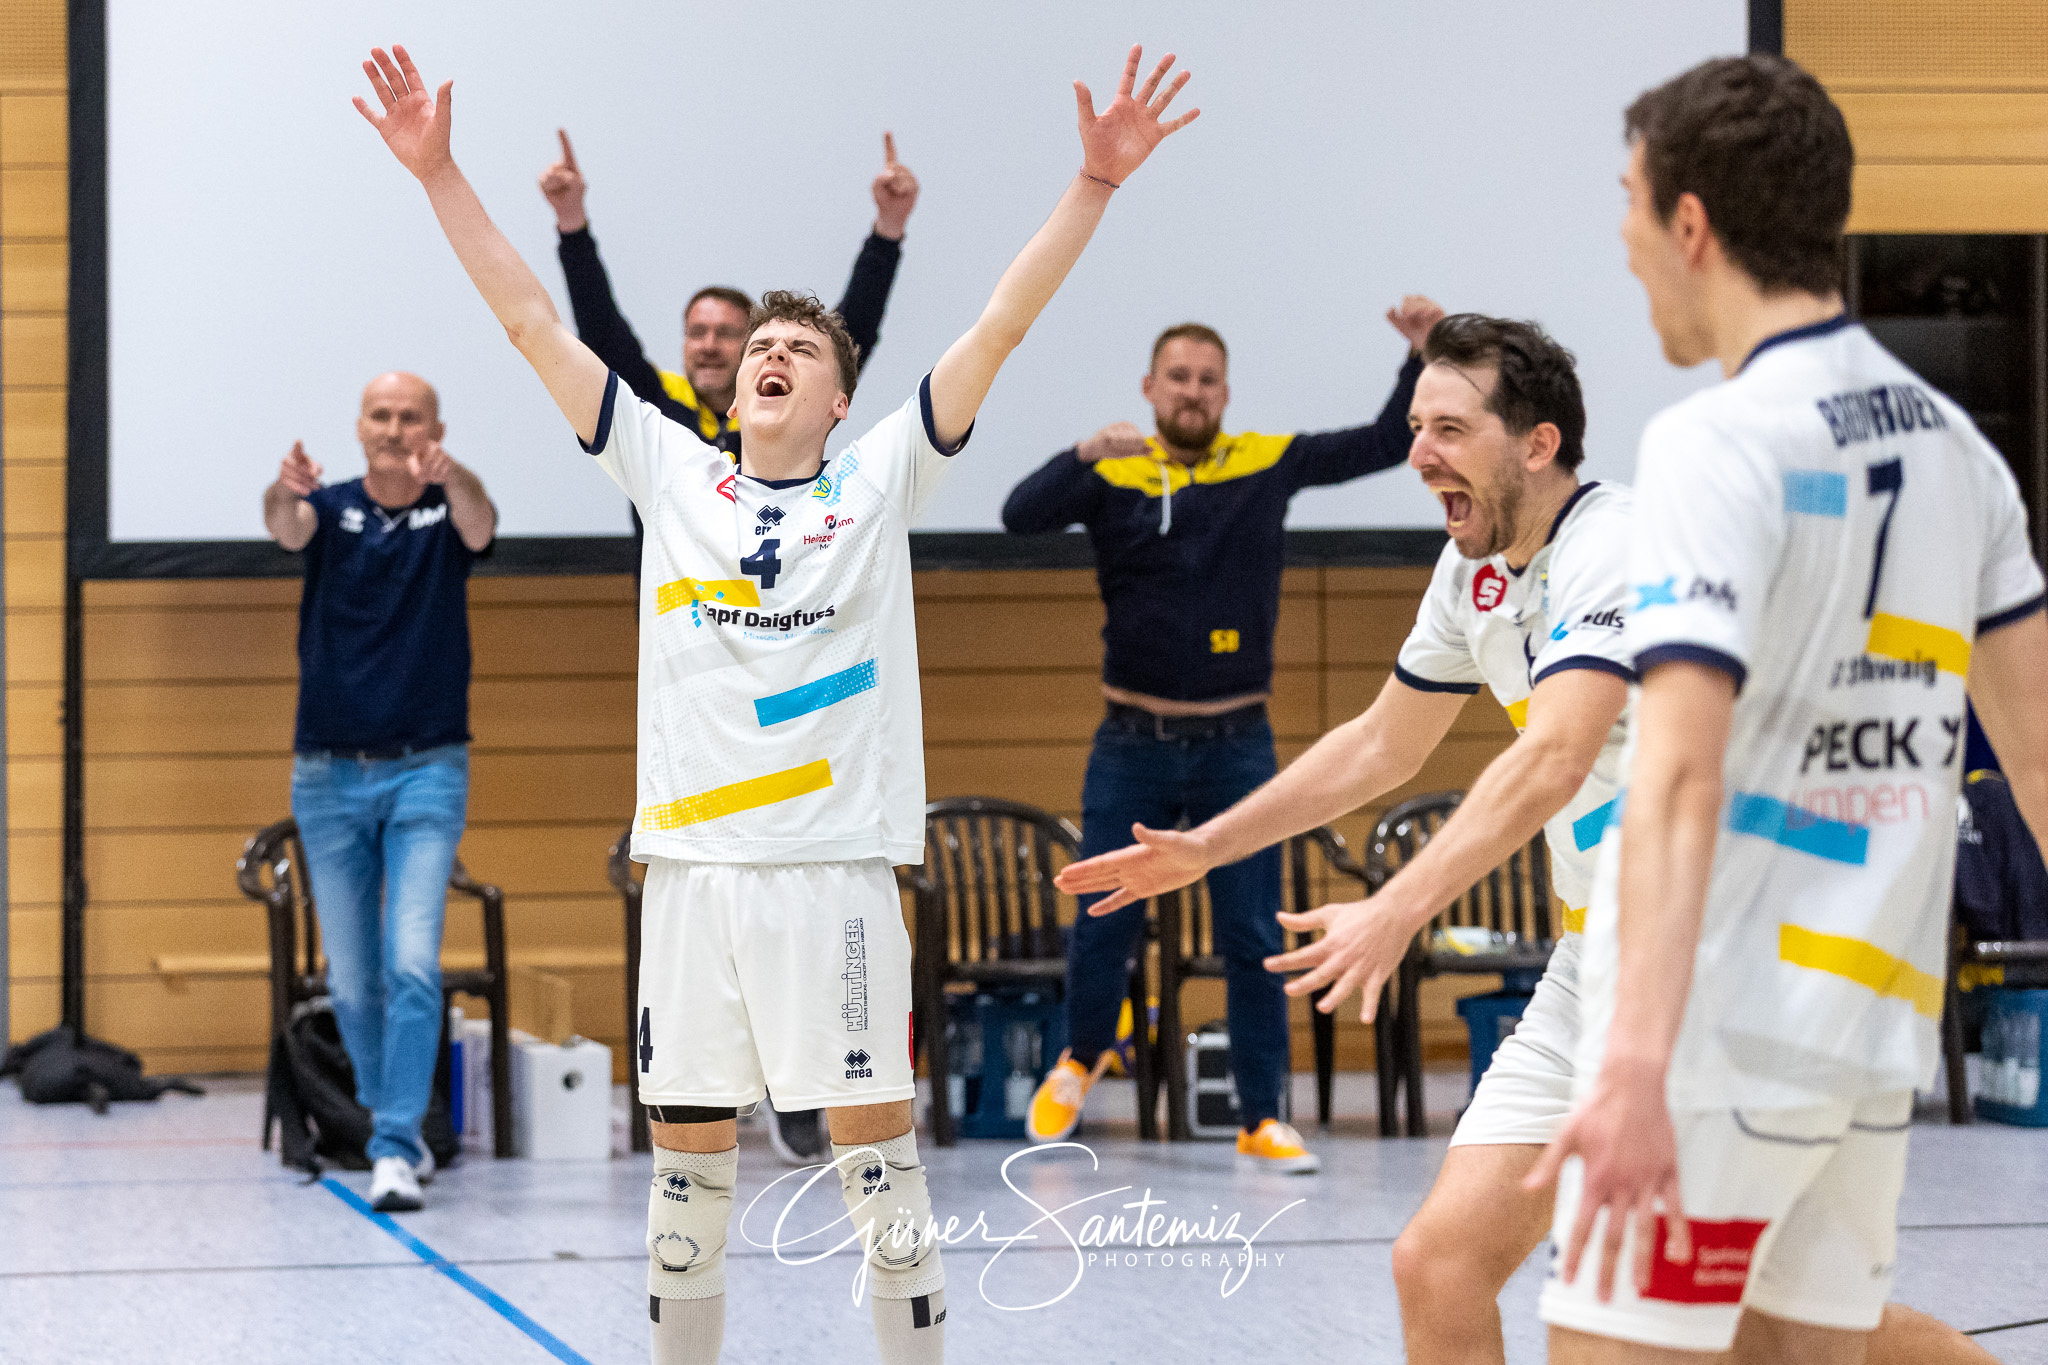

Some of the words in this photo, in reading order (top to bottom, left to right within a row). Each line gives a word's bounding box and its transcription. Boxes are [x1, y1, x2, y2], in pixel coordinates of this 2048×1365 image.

[1866, 457, 1904, 618] 7
[740, 539, 782, 590] 4
[703, 603, 742, 626] apf
[744, 604, 836, 632] Daigfuss
